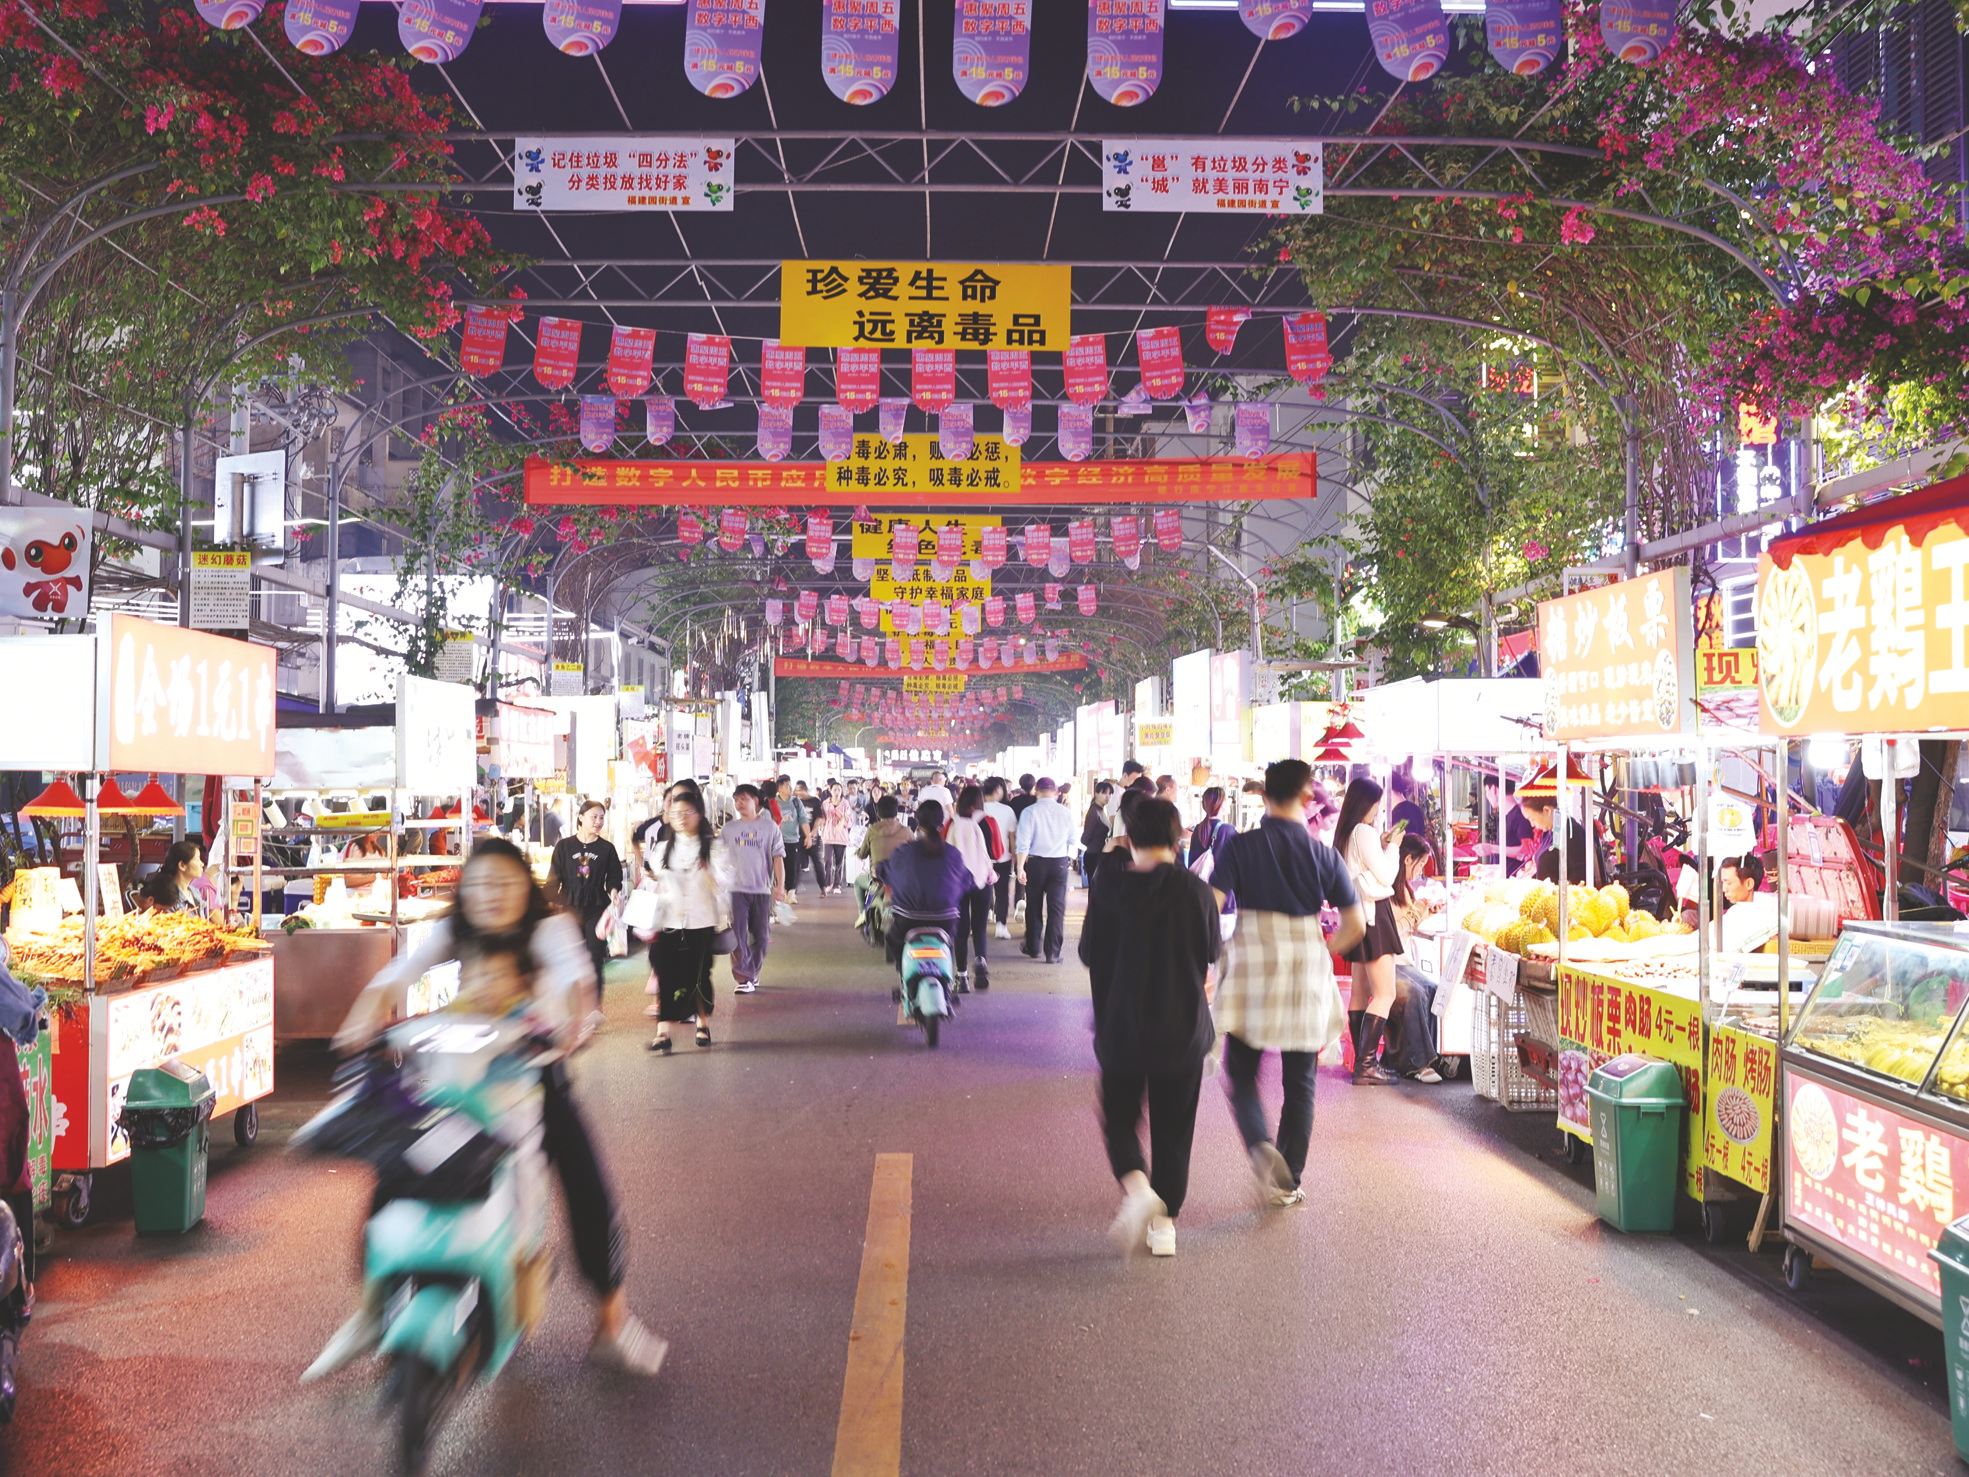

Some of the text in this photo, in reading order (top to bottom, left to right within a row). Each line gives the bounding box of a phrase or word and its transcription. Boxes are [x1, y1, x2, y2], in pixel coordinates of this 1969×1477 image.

[696, 12, 760, 29] 数字平西
[831, 18, 895, 33] 数字平西
[963, 18, 1026, 34] 数字平西
[1096, 18, 1160, 33] 数字平西
[568, 174, 688, 191] 分类投放找好家
[627, 195, 691, 205] 福建园街道 宣
[1216, 199, 1280, 209] 福建园街道 宣
[806, 265, 1001, 303] 珍爱生命
[852, 310, 1047, 346] 远离毒品
[847, 440, 1009, 462] 毒必肃，贩必惩，
[198, 554, 248, 566] 迷幻蘑菇
[876, 568, 967, 583] 坚抵制品
[894, 586, 984, 600] 守护幸福家庭
[1560, 972, 1622, 1055] 现炒板栗
[1624, 990, 1652, 1040] 肉肠
[1655, 1005, 1701, 1052] 4元一根
[1712, 1032, 1771, 1099] 肉肠 烤肠
[1704, 1131, 1729, 1172] 4元一根
[1740, 1146, 1769, 1192] 4元一根
